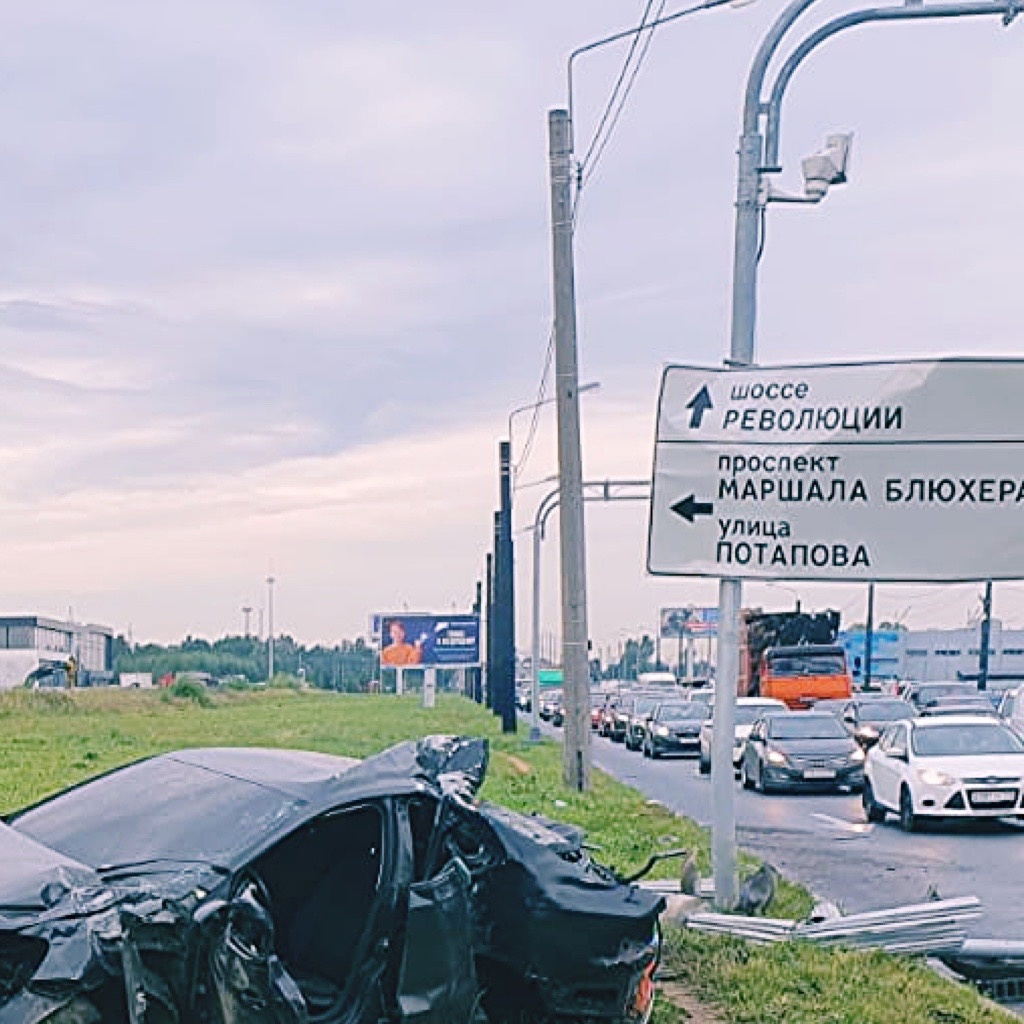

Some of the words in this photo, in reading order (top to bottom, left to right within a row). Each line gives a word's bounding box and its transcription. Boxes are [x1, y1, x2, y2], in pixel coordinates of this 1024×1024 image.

[730, 383, 809, 401] шоссе
[723, 406, 903, 432] РЕВОЛЮЦИИ
[718, 455, 840, 476] проспект
[718, 479, 867, 502] МАРШАЛА
[719, 518, 791, 540] улица
[716, 542, 871, 567] ПОТАПОВА
